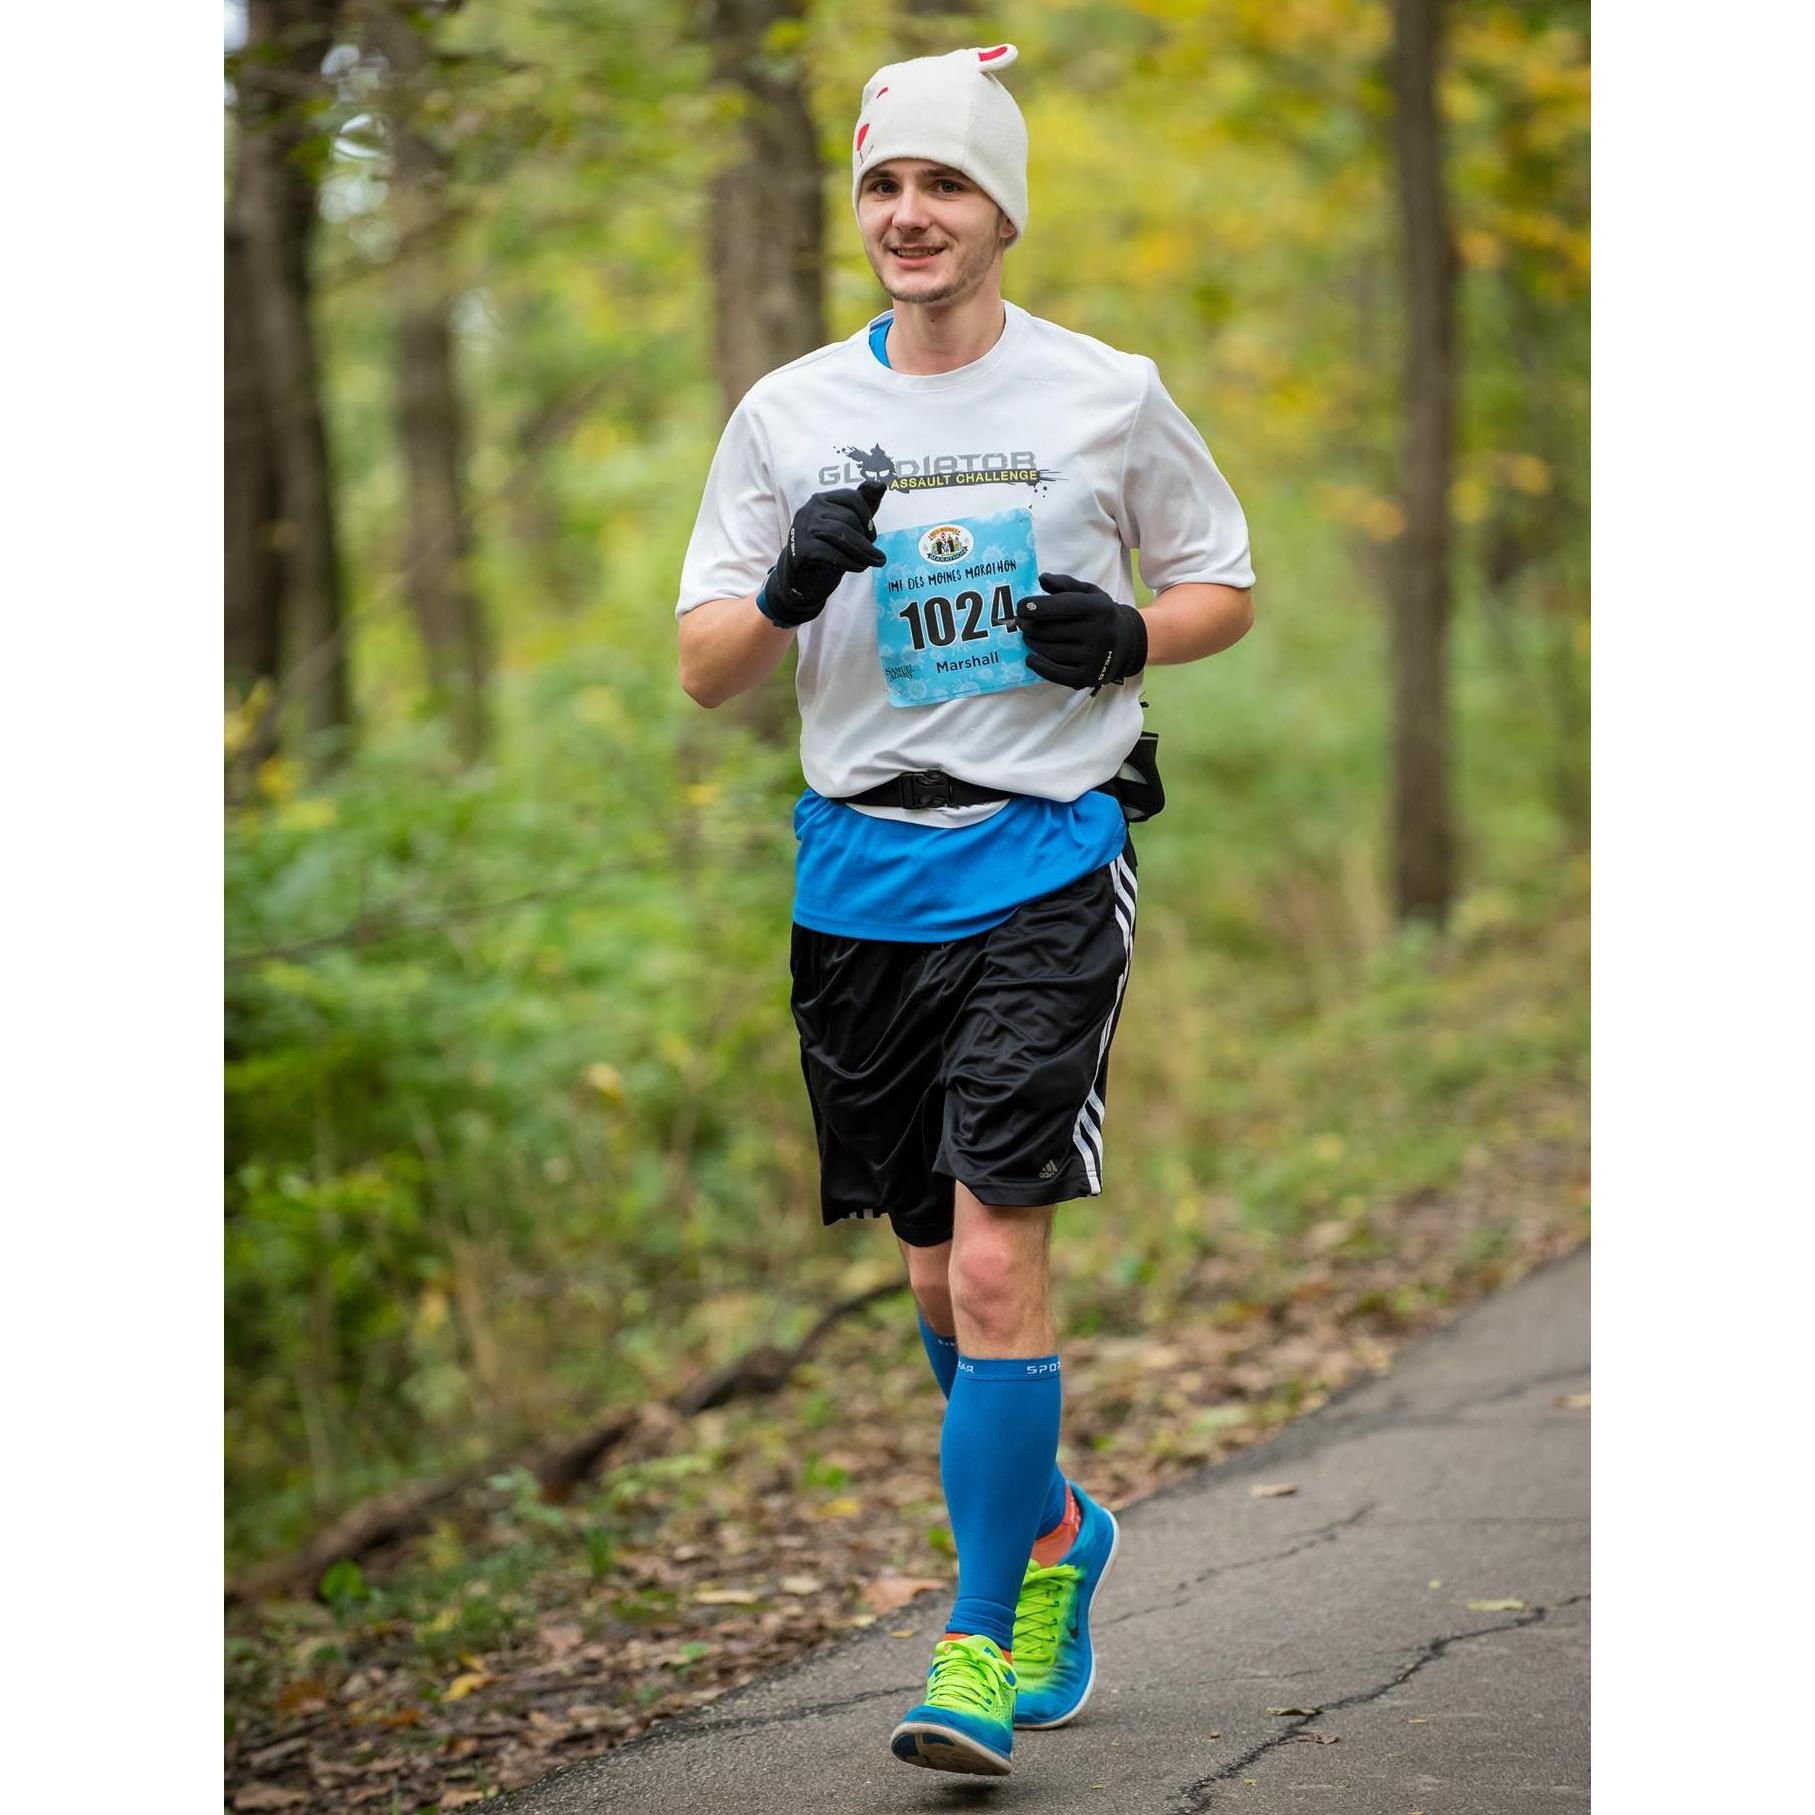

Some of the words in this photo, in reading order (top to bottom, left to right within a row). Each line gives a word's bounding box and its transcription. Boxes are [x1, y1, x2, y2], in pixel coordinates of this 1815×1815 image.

[818, 451, 1038, 486] GLDIATOR
[890, 474, 951, 490] ASSAULT
[955, 470, 1039, 484] CHALLENGE
[908, 576, 925, 590] DES
[928, 569, 962, 586] MOINES
[965, 559, 1017, 580] MARATHON
[899, 585, 1018, 650] 1024
[936, 651, 999, 673] Marshall
